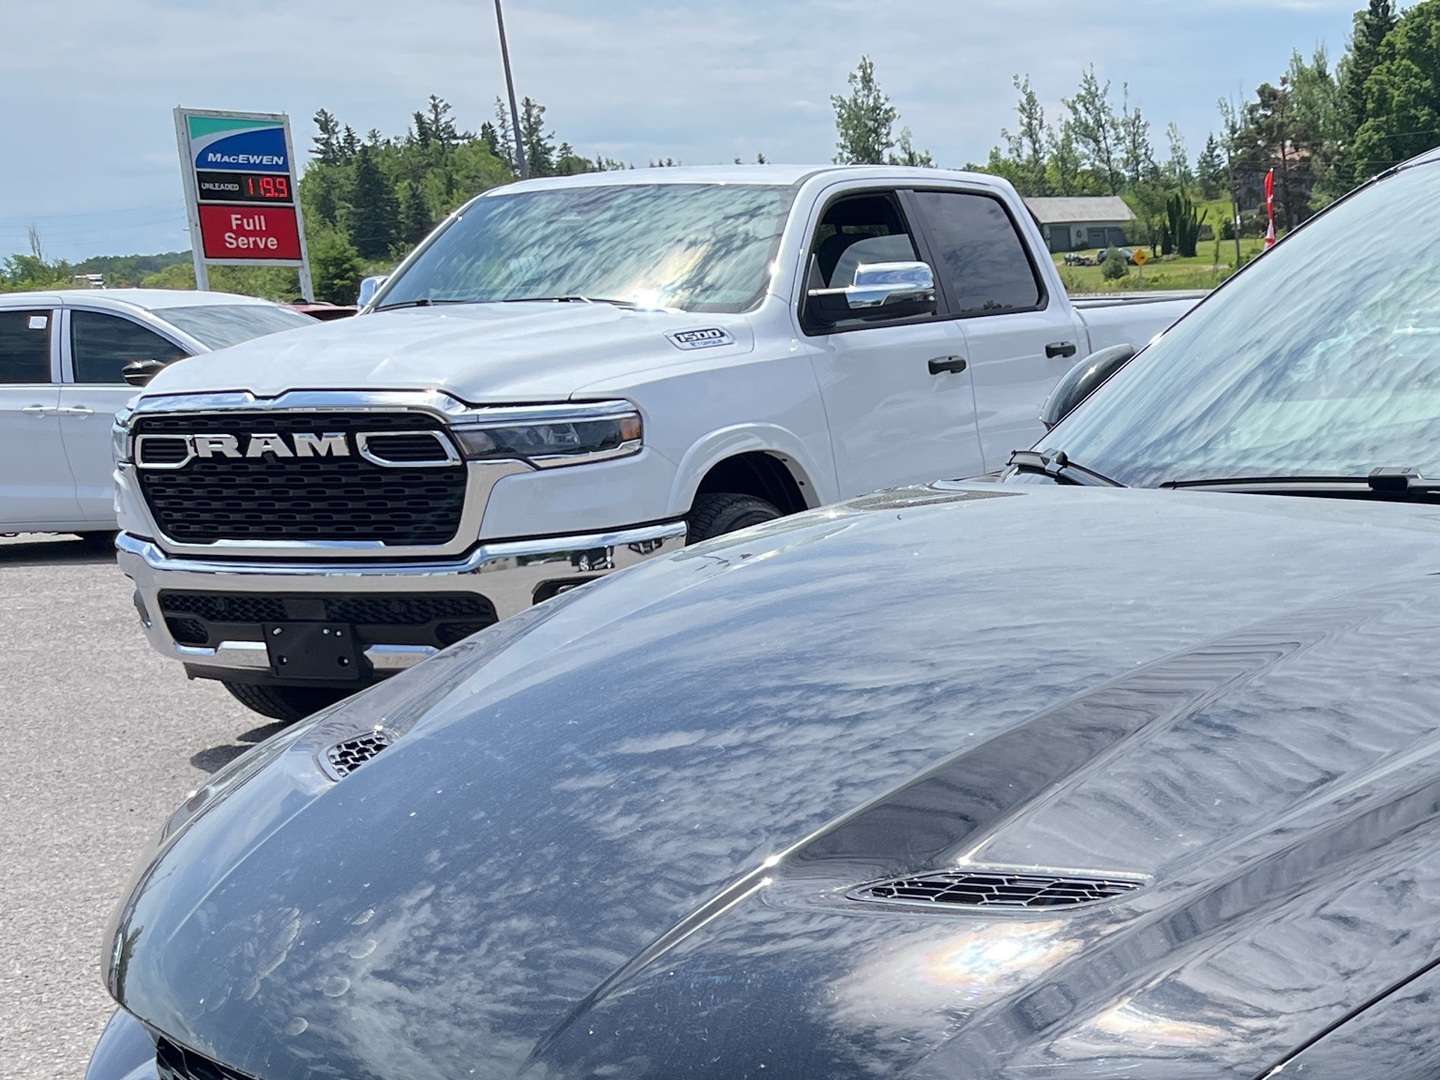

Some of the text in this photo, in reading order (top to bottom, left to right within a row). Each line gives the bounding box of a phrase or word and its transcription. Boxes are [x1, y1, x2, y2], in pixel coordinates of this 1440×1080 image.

[201, 182, 240, 191] UNLEADED
[230, 214, 266, 230] Full
[224, 232, 278, 250] Serve
[676, 329, 721, 343] 1500
[192, 432, 350, 458] RAM
